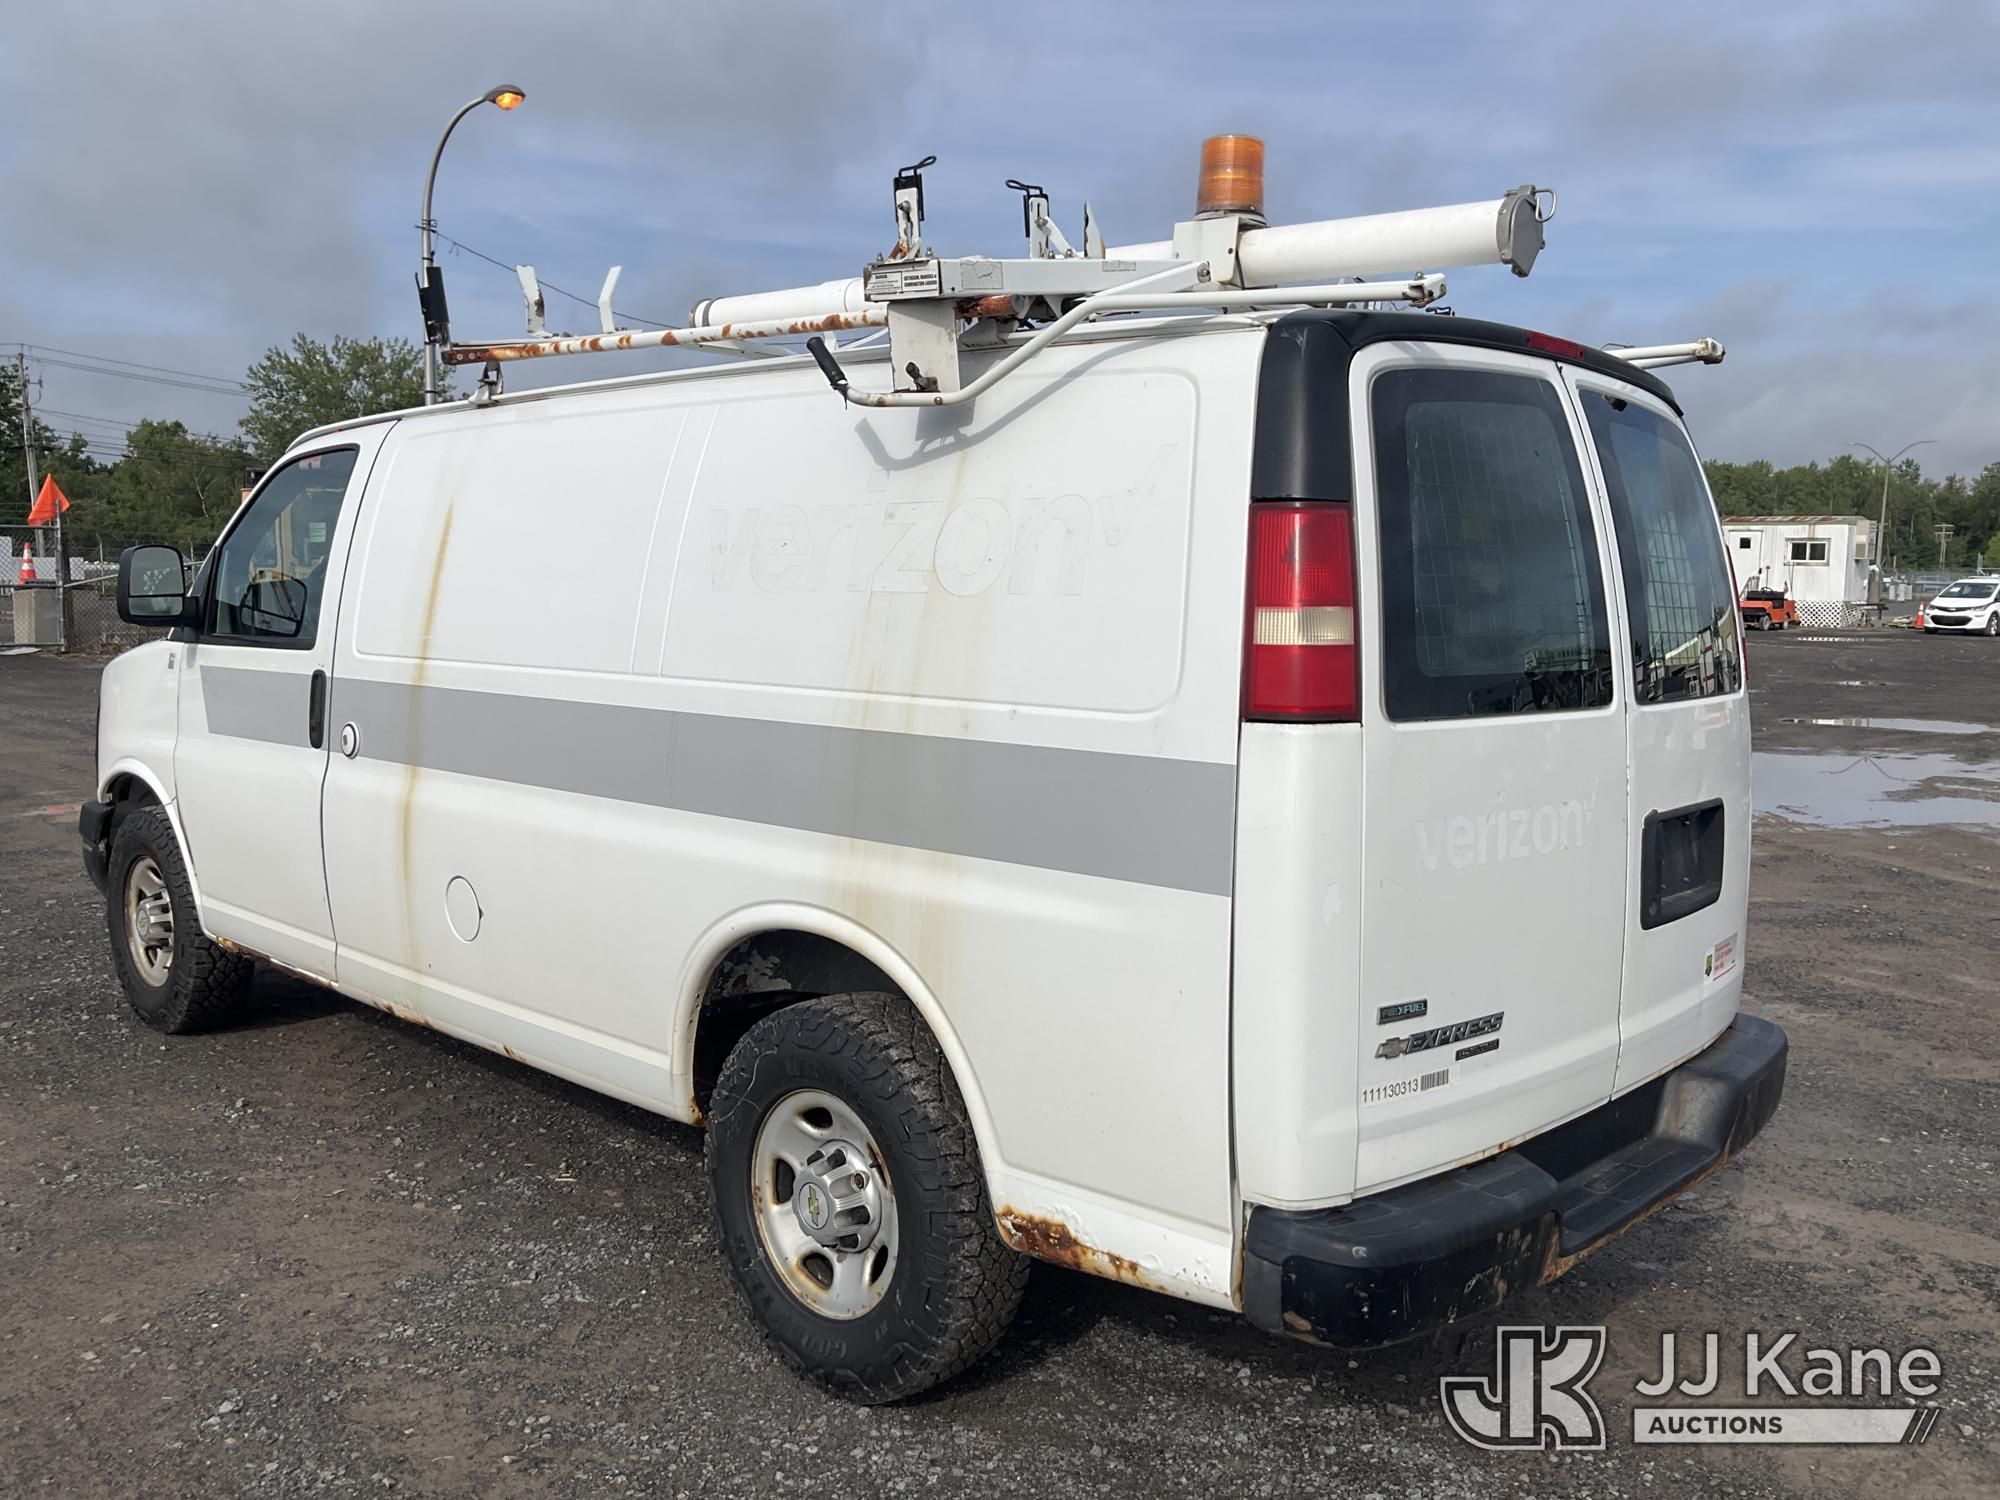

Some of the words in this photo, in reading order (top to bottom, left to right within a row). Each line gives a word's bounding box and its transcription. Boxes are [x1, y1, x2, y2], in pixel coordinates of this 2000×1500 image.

[709, 469, 1092, 597] verizon
[1414, 789, 1583, 872] verizon
[1406, 1011, 1505, 1054] EXPRESS
[1362, 1078, 1418, 1103] 111130313
